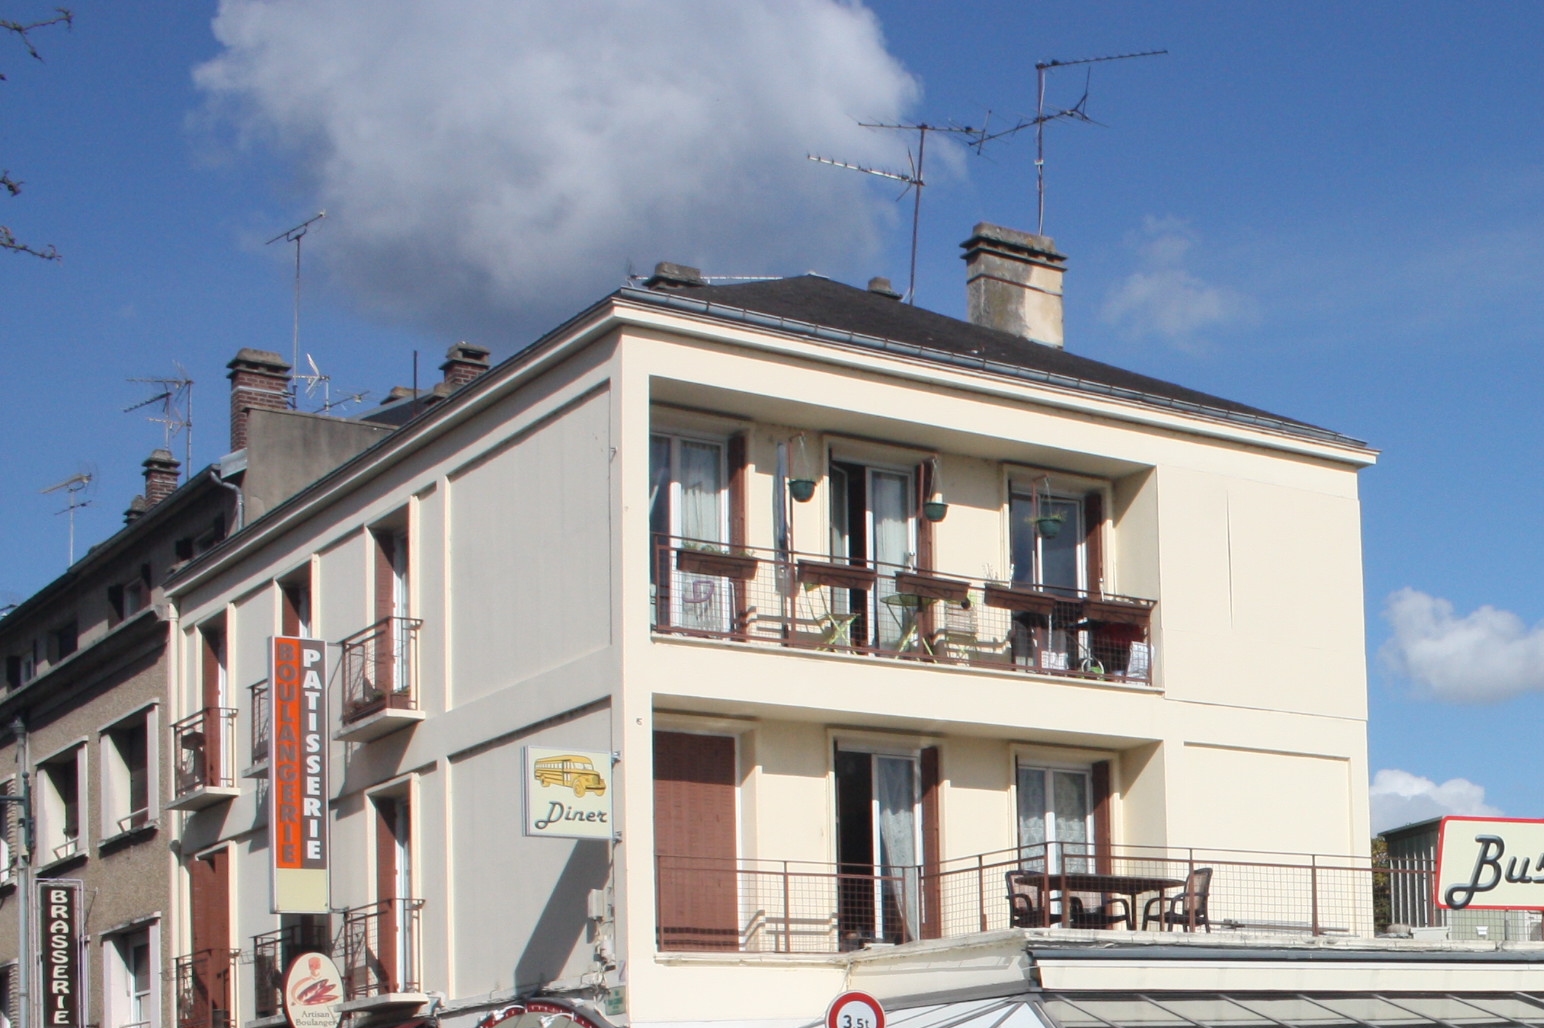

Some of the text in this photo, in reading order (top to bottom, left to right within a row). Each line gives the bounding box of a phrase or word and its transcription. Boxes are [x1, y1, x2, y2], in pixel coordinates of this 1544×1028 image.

[277, 642, 298, 864] BOULANGERIE
[302, 648, 323, 860] PATISSERIE
[534, 801, 608, 830] Diner
[50, 889, 70, 1025] BRASSERIE
[296, 1019, 337, 1027] Boulanger
